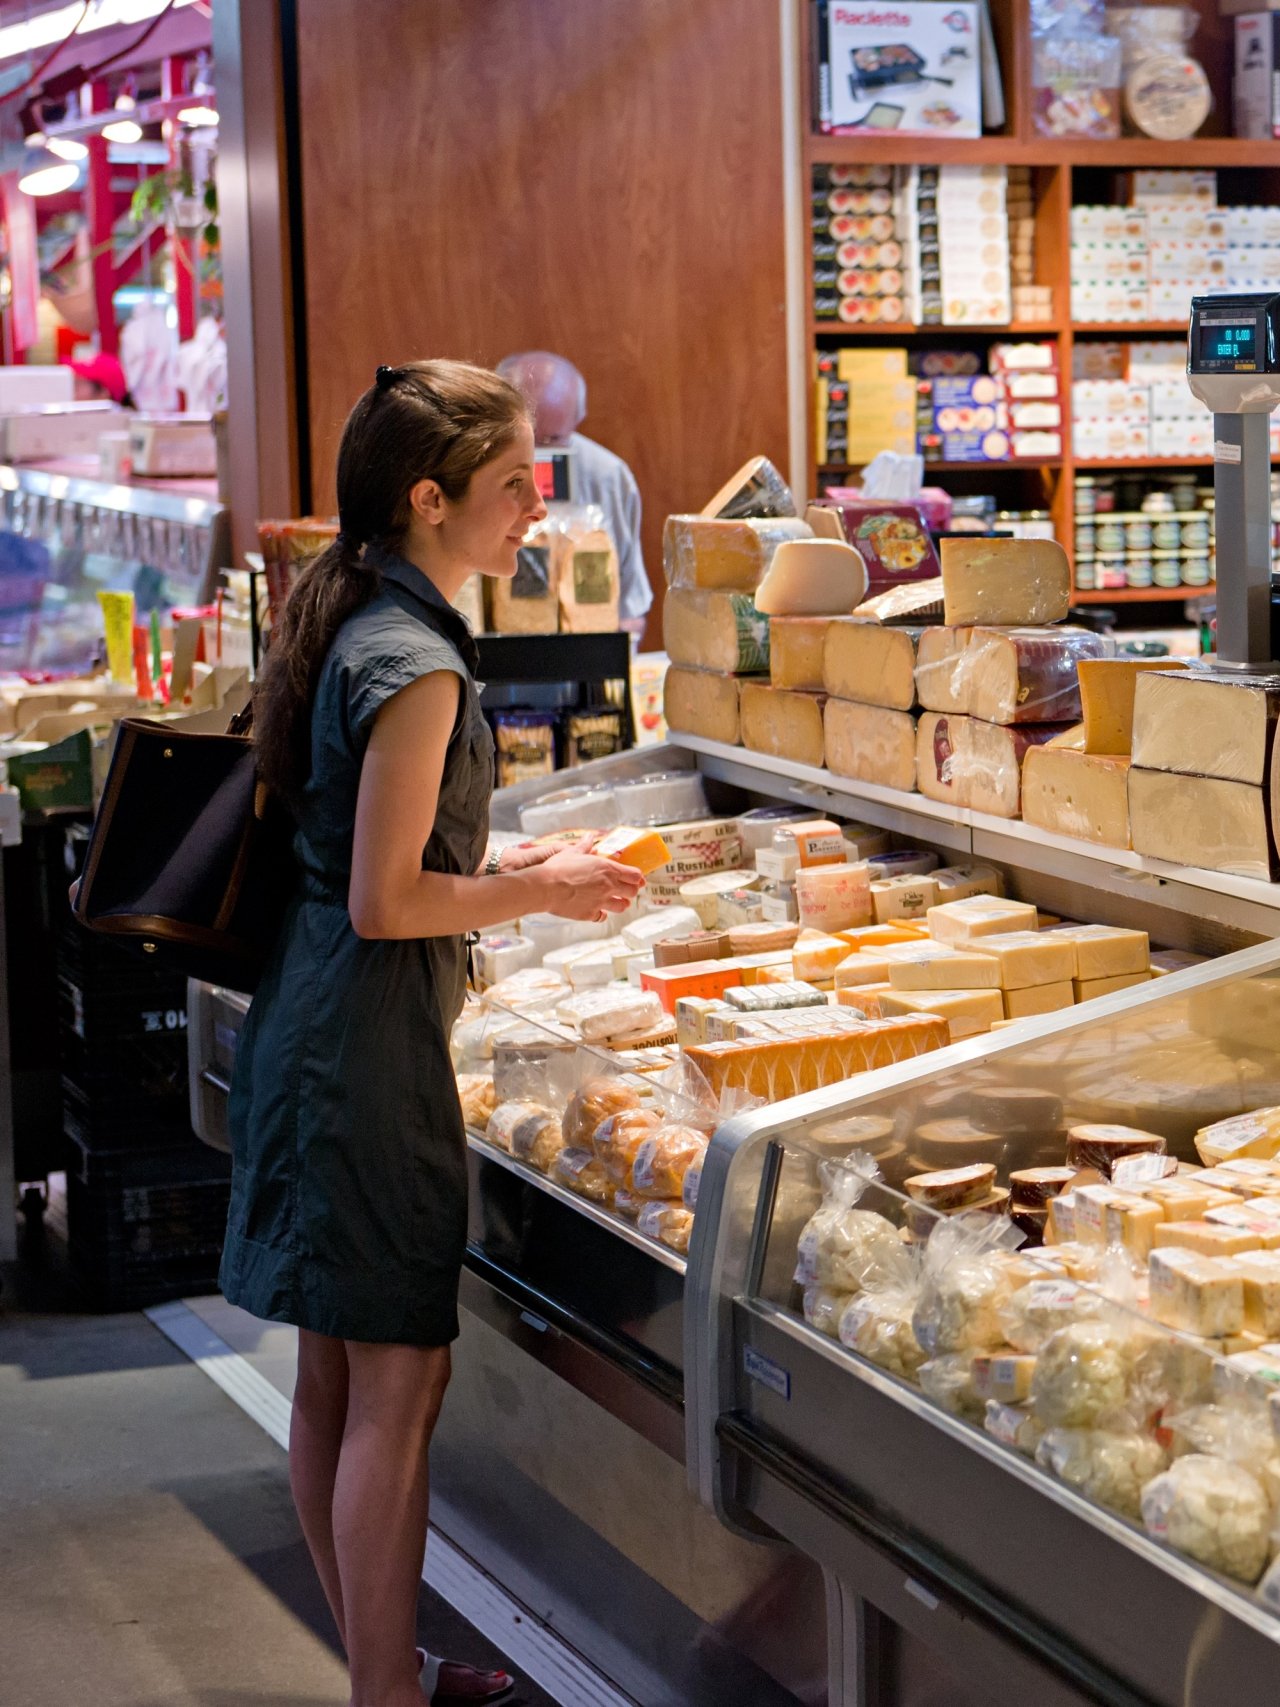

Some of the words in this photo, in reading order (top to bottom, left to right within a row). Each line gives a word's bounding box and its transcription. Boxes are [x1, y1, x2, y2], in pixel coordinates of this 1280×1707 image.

[835, 8, 910, 26] Raclette
[1218, 344, 1232, 355] ENTER
[665, 864, 675, 874] LE
[659, 885, 680, 896] RUST
